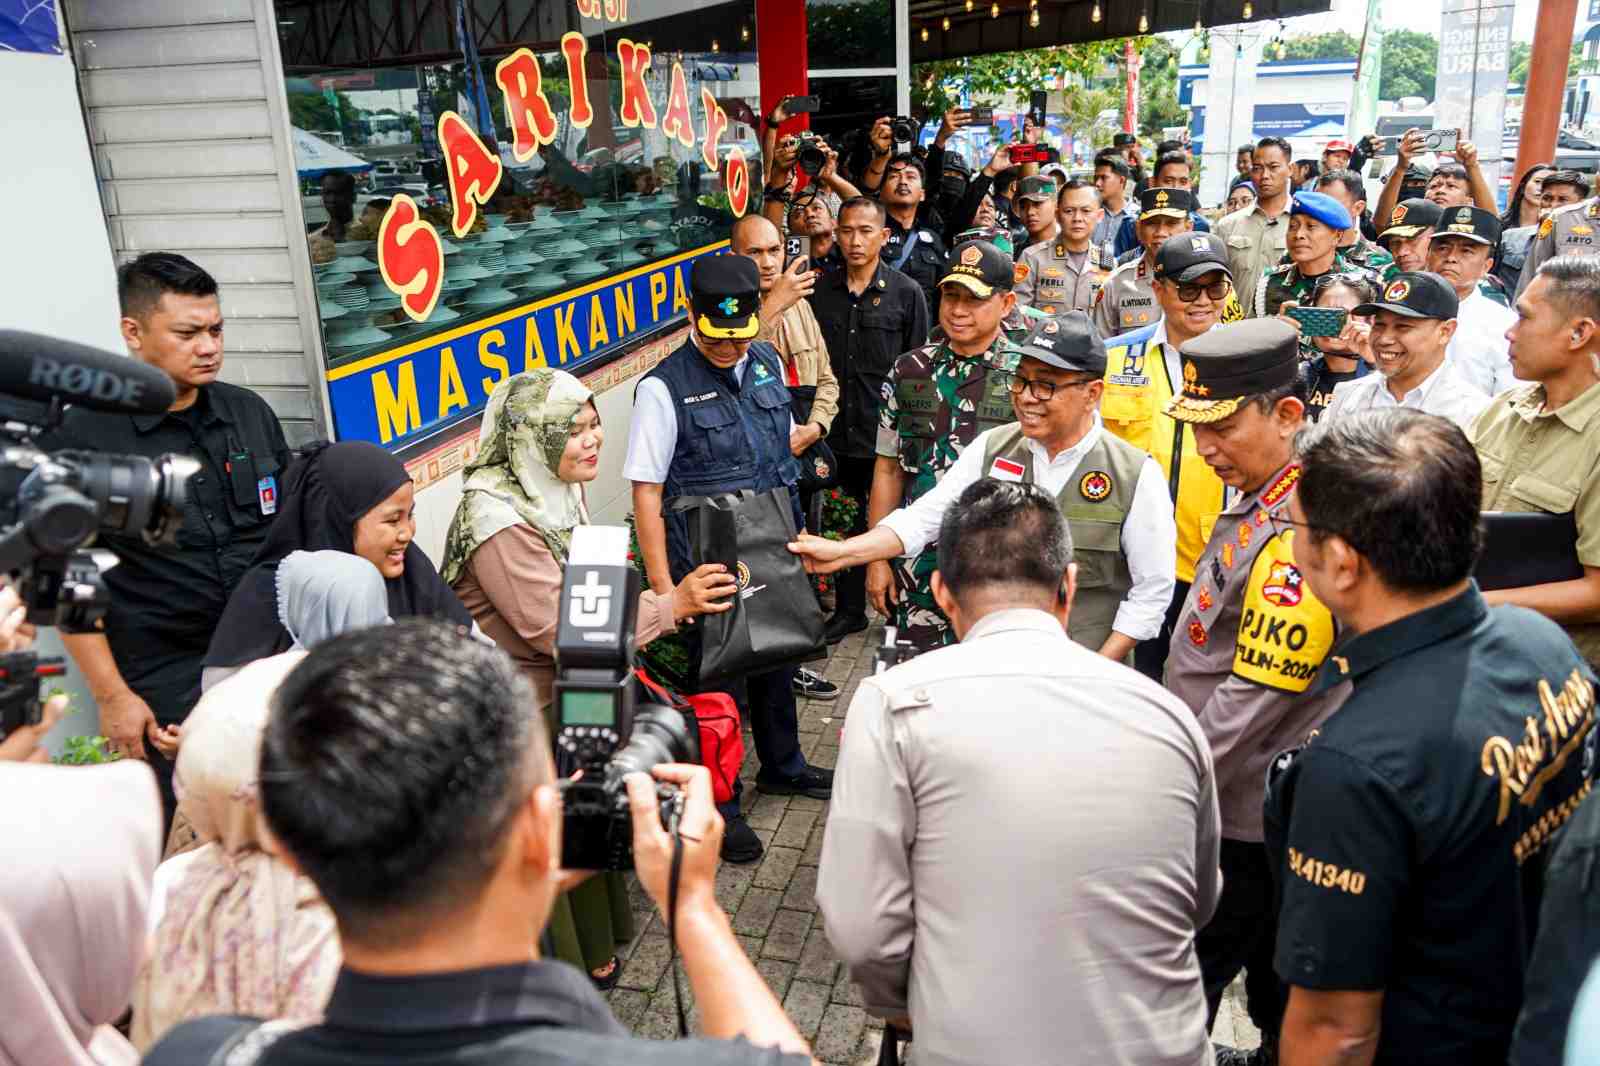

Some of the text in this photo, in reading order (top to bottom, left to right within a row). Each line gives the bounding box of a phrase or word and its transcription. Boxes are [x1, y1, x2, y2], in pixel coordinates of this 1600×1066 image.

[371, 282, 637, 444] MASAKAN
[649, 265, 689, 323] PA
[1241, 608, 1308, 651] PJKO
